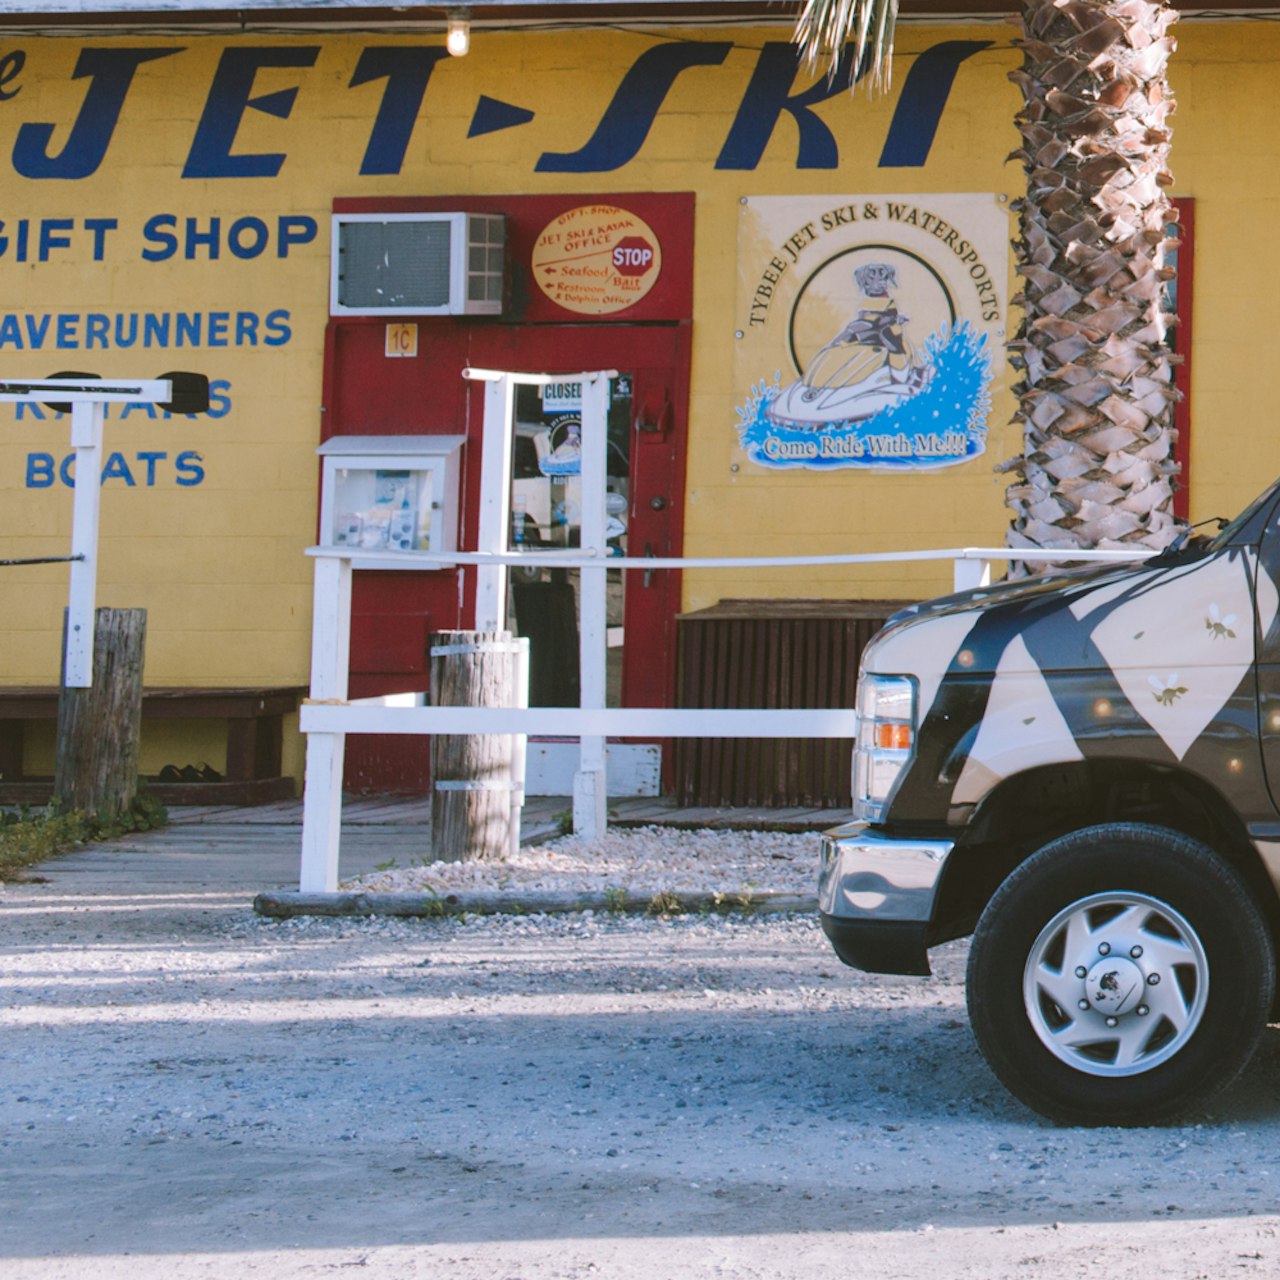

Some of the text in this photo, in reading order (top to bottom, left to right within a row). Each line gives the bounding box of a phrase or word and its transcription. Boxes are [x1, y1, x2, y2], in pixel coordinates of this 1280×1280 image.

[0, 214, 318, 262] IFT SHOP
[540, 233, 561, 246] JET
[567, 229, 585, 240] SKI
[597, 219, 634, 233] KAYAK
[564, 235, 612, 252] OFFICE
[613, 248, 652, 266] STOP
[750, 202, 1000, 327] TYBEE JET SKI & WATERSPORTS
[557, 282, 606, 293] Restroom
[393, 329, 410, 350] 1C
[764, 434, 968, 456] Come Ride With Me!!!
